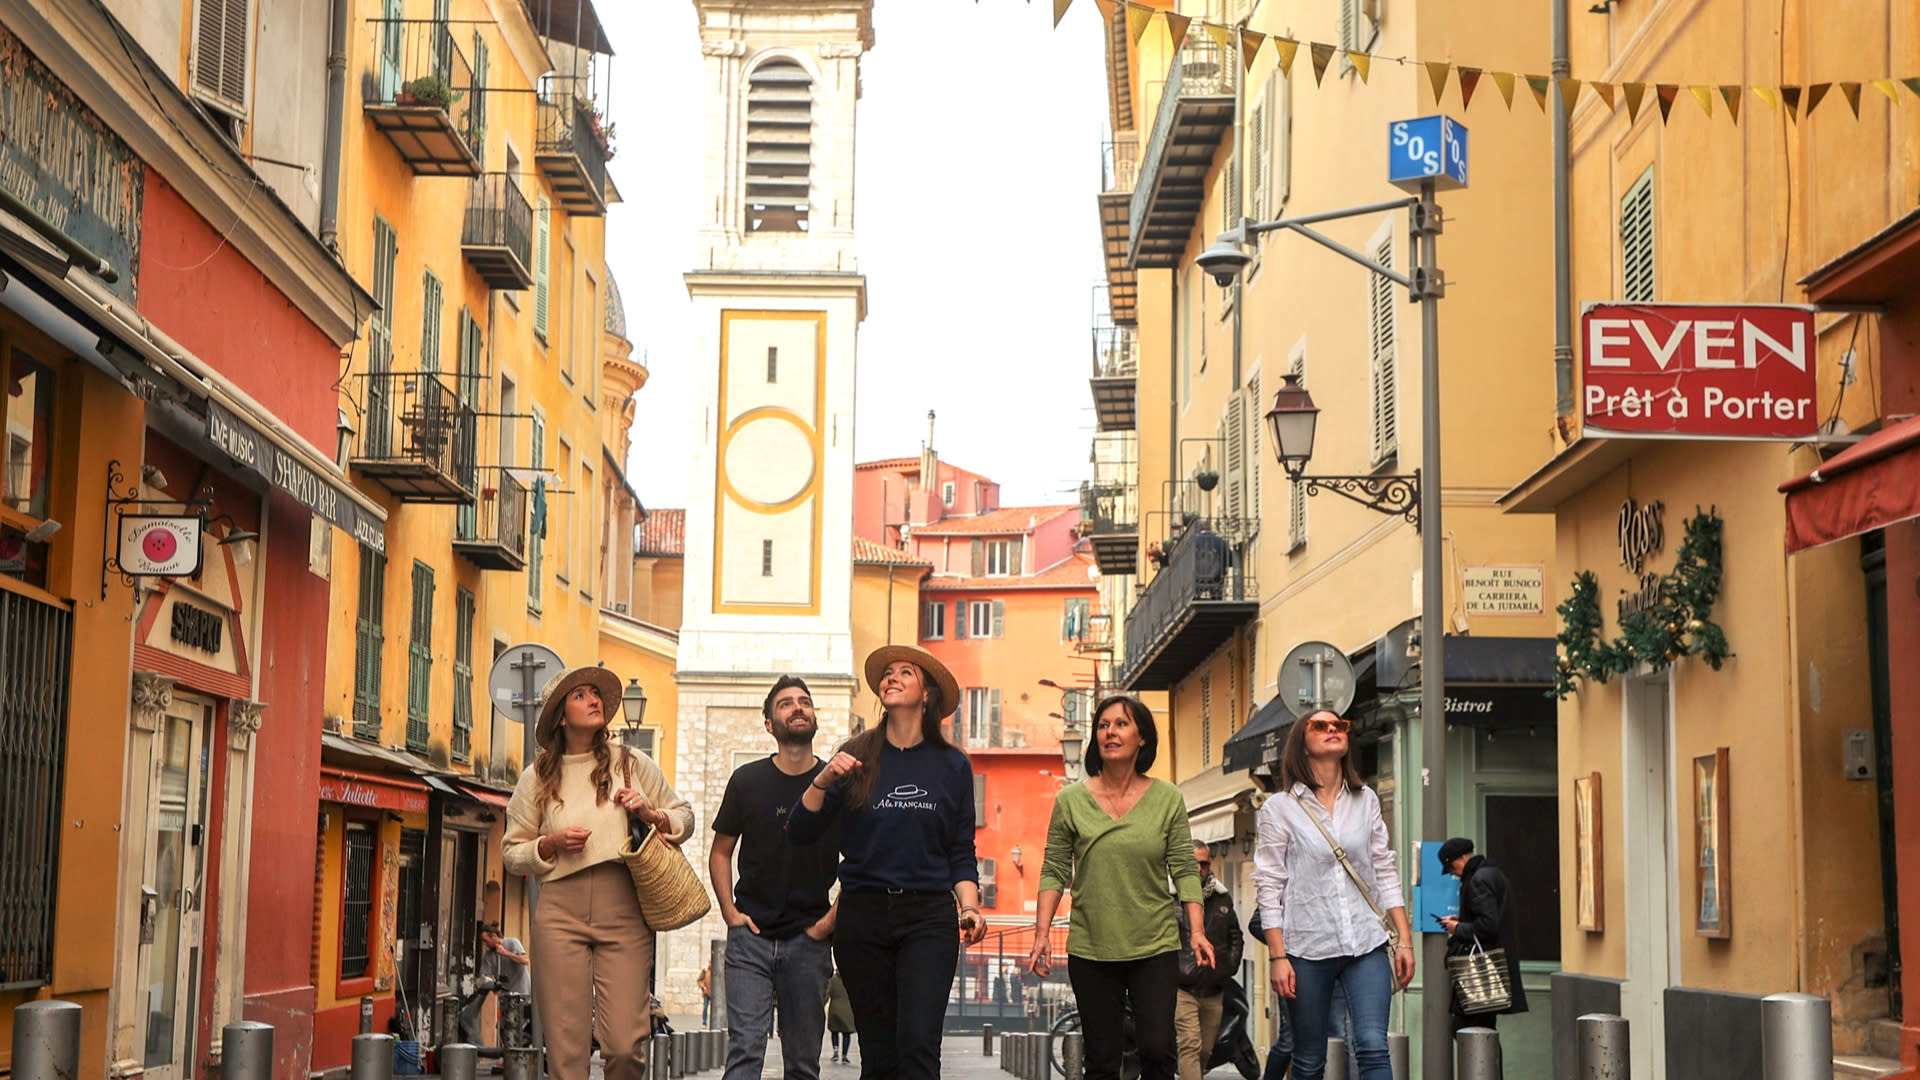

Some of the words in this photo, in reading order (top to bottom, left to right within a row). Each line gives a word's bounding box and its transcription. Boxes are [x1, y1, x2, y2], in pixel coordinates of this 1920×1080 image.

[1393, 122, 1439, 175] SOS
[1446, 119, 1466, 184] SOS
[46, 193, 69, 232] 1907
[1589, 318, 1806, 373] EVEN
[1586, 385, 1654, 418] Prêt
[1667, 386, 1688, 418] à
[1704, 387, 1811, 419] Porter
[210, 415, 228, 449] LIVE
[229, 430, 255, 465] MUSIC
[275, 451, 317, 505] SHAPKO
[319, 481, 337, 521] BAR
[354, 517, 369, 542] JAZZ
[370, 525, 384, 552] CLUB
[1492, 570, 1512, 578] RUE
[1504, 579, 1541, 588] BUNICO
[1466, 602, 1478, 610] DE
[1483, 602, 1495, 610] LA
[1478, 592, 1527, 601] CARRIERA
[1443, 696, 1493, 713] Bistrot
